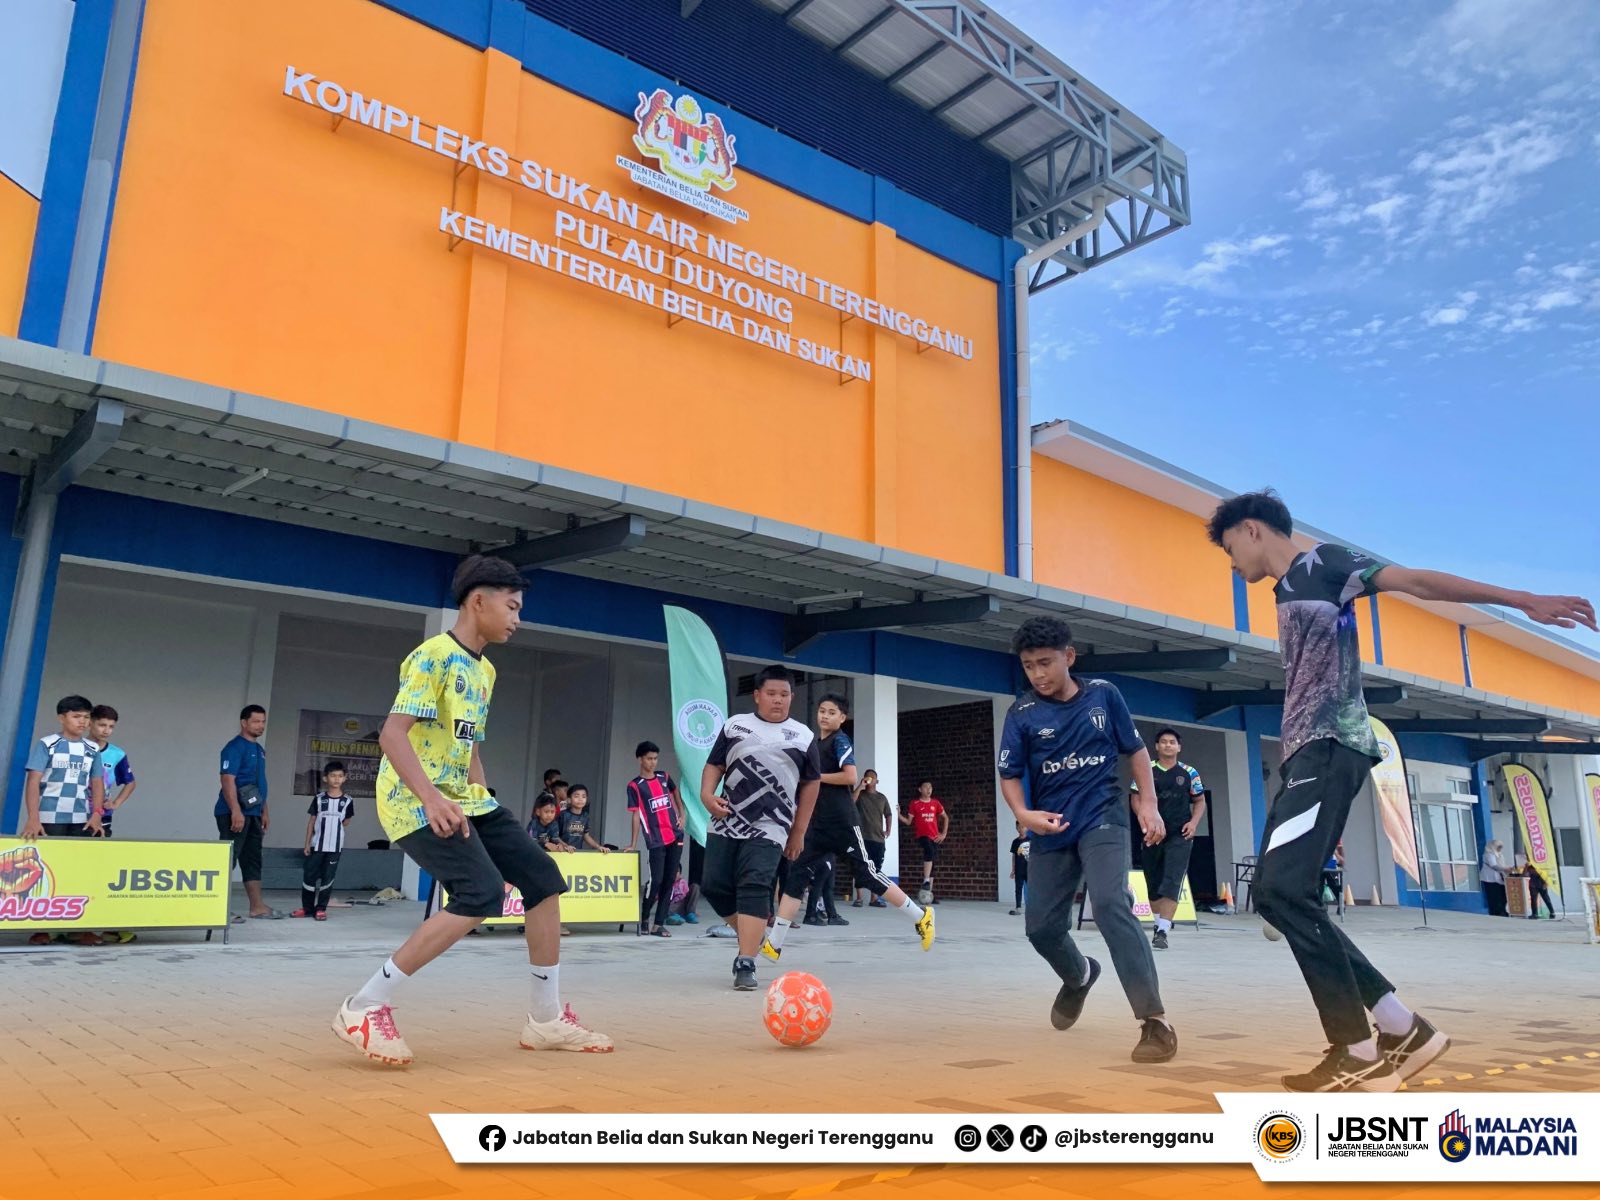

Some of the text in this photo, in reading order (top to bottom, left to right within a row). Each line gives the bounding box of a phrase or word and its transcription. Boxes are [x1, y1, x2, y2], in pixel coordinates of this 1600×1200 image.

[284, 65, 973, 360] KOMPLEKS SUKAN AIR NEGERI TERENGGANU
[618, 157, 677, 188] KEMENTERIAN
[679, 183, 703, 199] BELIA
[704, 194, 720, 206] DAN
[722, 201, 748, 219] SUKAN
[633, 173, 668, 193] JABATAN
[669, 188, 691, 202] BELIA
[693, 198, 708, 210] DAN
[710, 206, 736, 222] SUKAN
[440, 207, 870, 381] KEMENTERIAN BELIA DAN SUKAN
[555, 210, 793, 323] PULAU DUYONG
[108, 869, 219, 891] JBSNT
